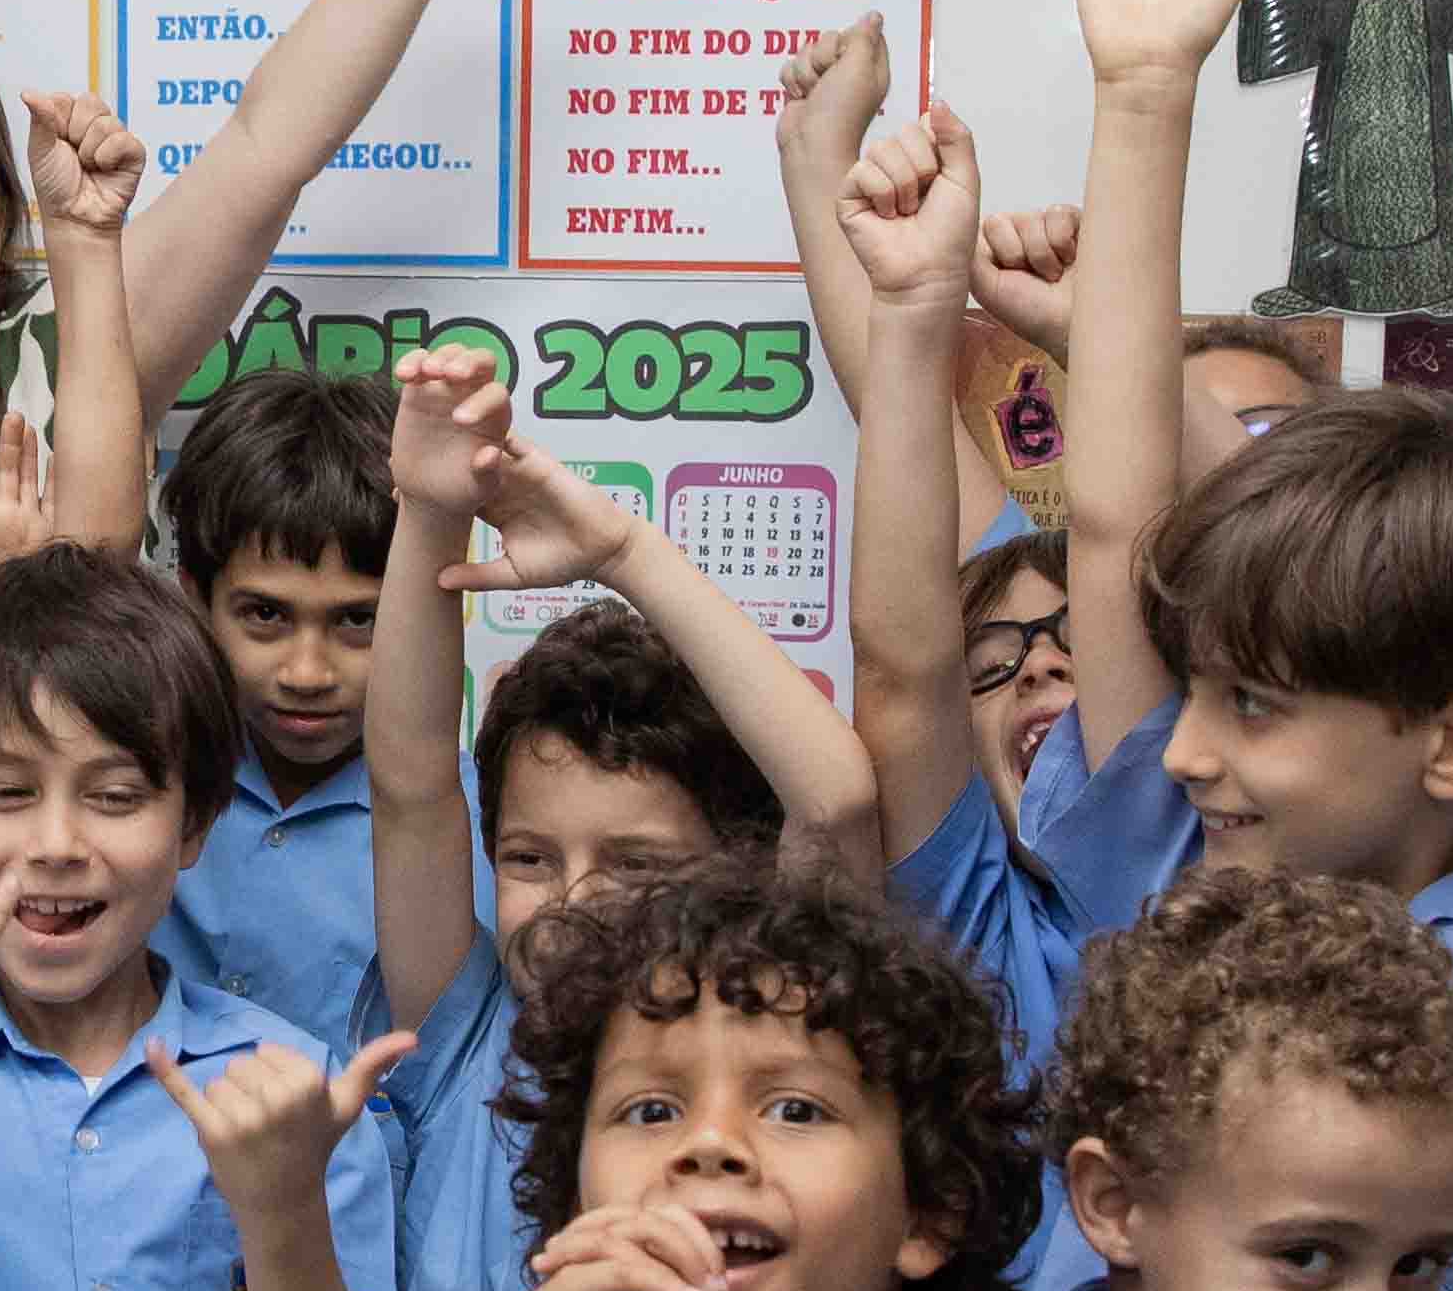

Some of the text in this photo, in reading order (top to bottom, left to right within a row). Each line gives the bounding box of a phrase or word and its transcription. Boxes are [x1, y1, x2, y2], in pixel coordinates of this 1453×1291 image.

[568, 30, 752, 55] NO FIM DO
[567, 89, 616, 116] NO
[629, 89, 690, 116] FIM
[702, 89, 747, 115] DE
[566, 148, 722, 175] NO FIM...
[566, 208, 707, 236] ENFIM...
[534, 320, 814, 422] 2025
[718, 465, 785, 484] JUNHO
[678, 493, 825, 511] D S T Q Q S S
[701, 510, 709, 522] 2
[724, 511, 731, 523] 3
[746, 512, 754, 524] 4
[769, 512, 777, 524] 5
[793, 512, 801, 524] 6
[815, 513, 823, 525] 7
[1033, 512, 1053, 527] QUE
[701, 528, 709, 539] 9
[722, 529, 734, 540] 10
[744, 530, 754, 540] 11
[767, 530, 778, 540] 12
[790, 530, 801, 541] 13
[812, 531, 824, 542] 14
[698, 545, 710, 557] 16
[721, 545, 732, 557] 17
[743, 546, 755, 558] 18
[787, 547, 802, 559] 20
[812, 548, 824, 560] 21
[718, 564, 824, 578] 24 25 26 27 28
